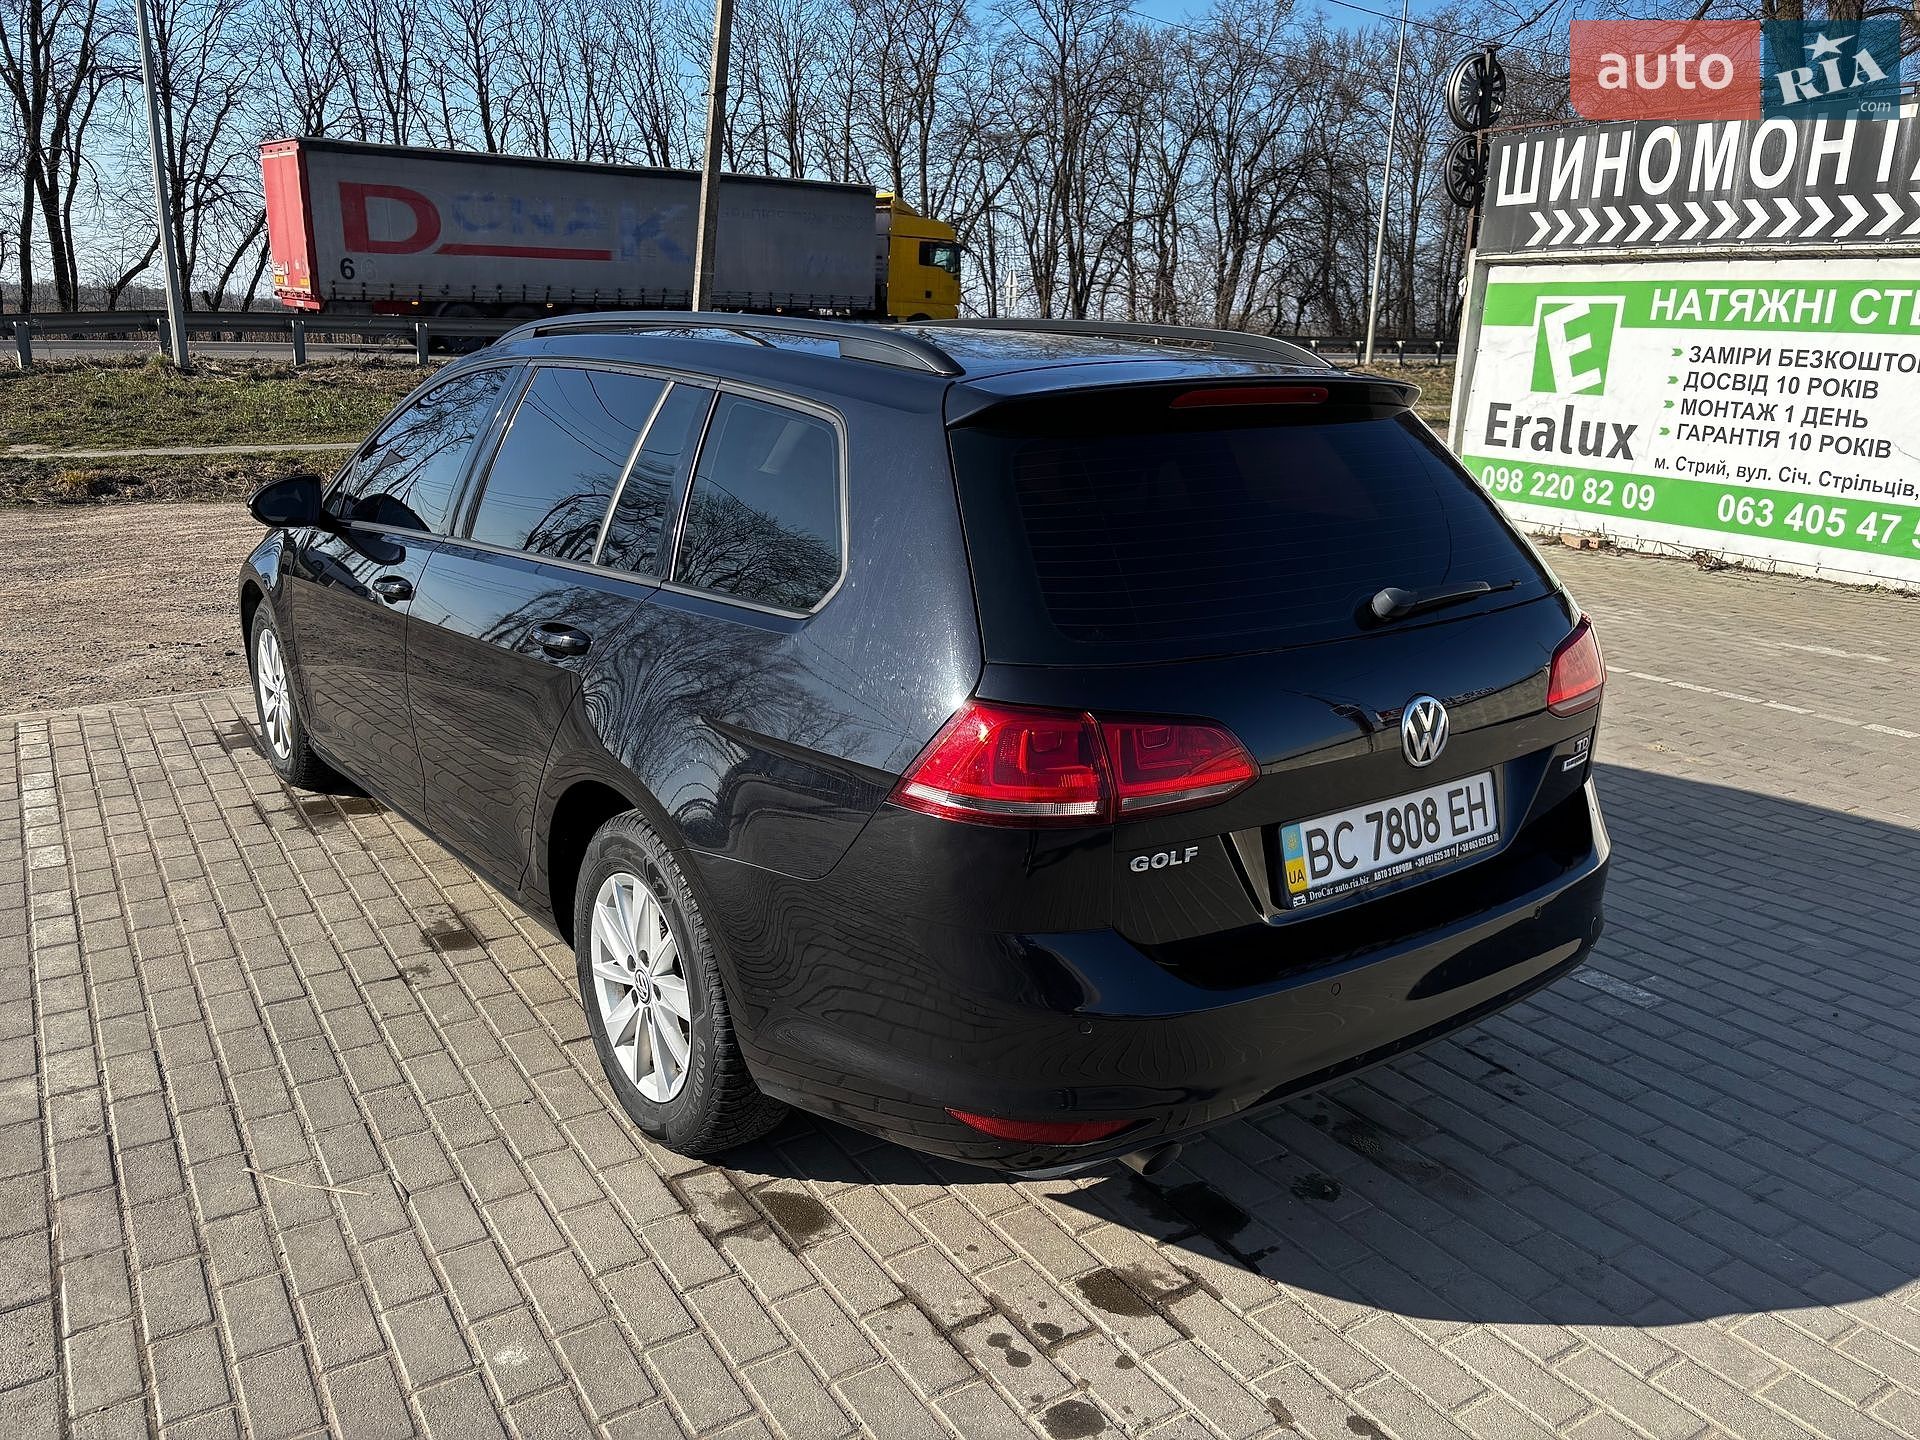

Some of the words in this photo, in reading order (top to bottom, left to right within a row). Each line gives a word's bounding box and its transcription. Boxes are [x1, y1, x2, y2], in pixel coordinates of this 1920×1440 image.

[1495, 103, 1920, 206] ШИНОМОНТ
[1649, 288, 1837, 324] НАТЯЖНІ
[1688, 345, 1772, 368] ЗАМІРИ
[1777, 348, 1920, 374] БЕЗКОШТО
[1683, 371, 1769, 397] ДОСВІД
[1775, 376, 1800, 396] 10
[1806, 377, 1880, 400] РОКІВ
[1484, 402, 1638, 460] Eralux
[1680, 398, 1778, 423] МОНТАЖ
[1784, 404, 1794, 424] 1
[1800, 406, 1869, 429] ДЕНЬ
[1675, 423, 1780, 449] ГАРАНТІЯ
[1788, 431, 1812, 451] 10
[1818, 434, 1892, 459] РОКІВ
[1480, 464, 1523, 494] 098
[1530, 470, 1575, 502] 220
[1581, 478, 1613, 507] 82
[1620, 481, 1656, 512] 09
[1653, 458, 1669, 470] м.
[1674, 455, 1731, 481] Стрий,
[1736, 464, 1773, 484] вул.
[1778, 466, 1812, 487] Січ.
[1818, 470, 1919, 501] Стрільців,
[1716, 493, 1775, 528] 063
[1784, 501, 1848, 538] 405
[1856, 511, 1903, 544] 47
[1305, 820, 1359, 880] BC
[1365, 796, 1441, 861] 7808
[1447, 782, 1489, 837] EH
[1130, 846, 1199, 873] GOLF
[1289, 869, 1305, 884] UA
